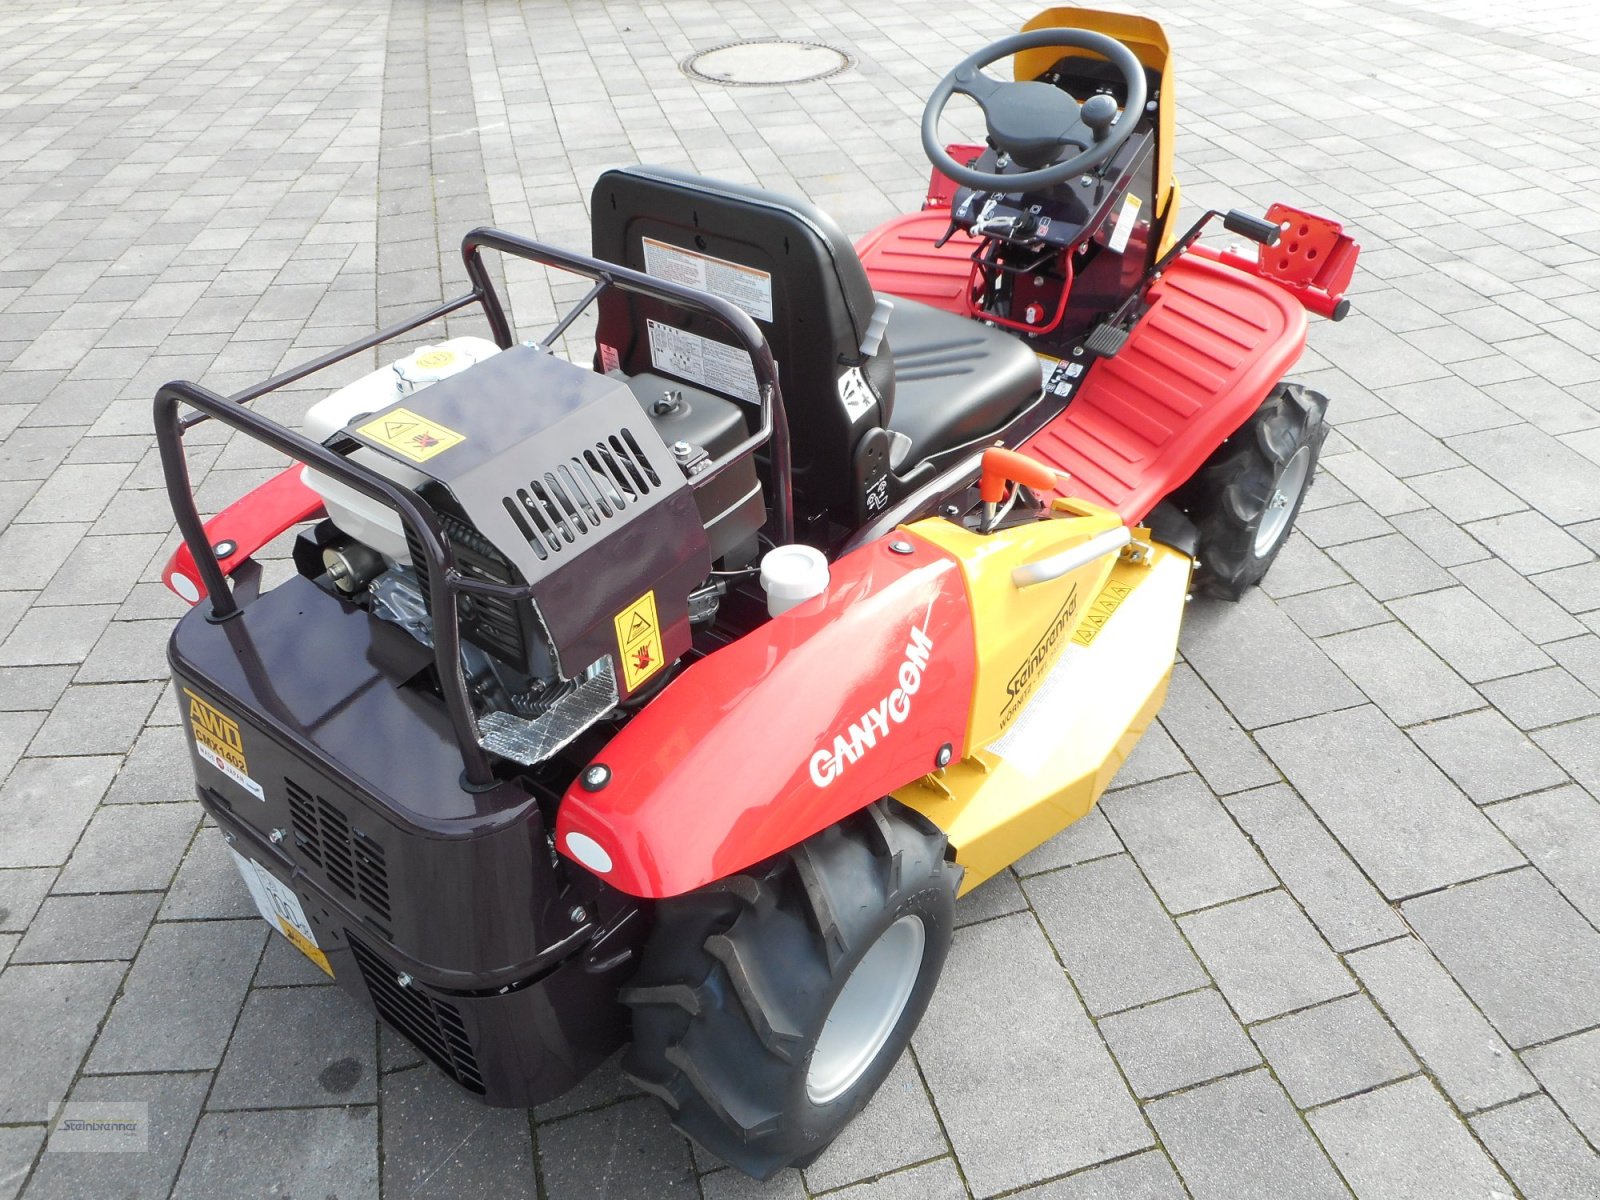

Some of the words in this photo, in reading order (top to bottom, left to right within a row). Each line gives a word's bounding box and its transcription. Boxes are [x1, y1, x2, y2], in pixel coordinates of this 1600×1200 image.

[1000, 588, 1077, 714] Steinbrenner
[191, 699, 243, 754] AWD
[809, 625, 933, 788] CANYCOM
[1000, 684, 1032, 730] WÖRNITZ
[195, 730, 247, 774] CMX1402
